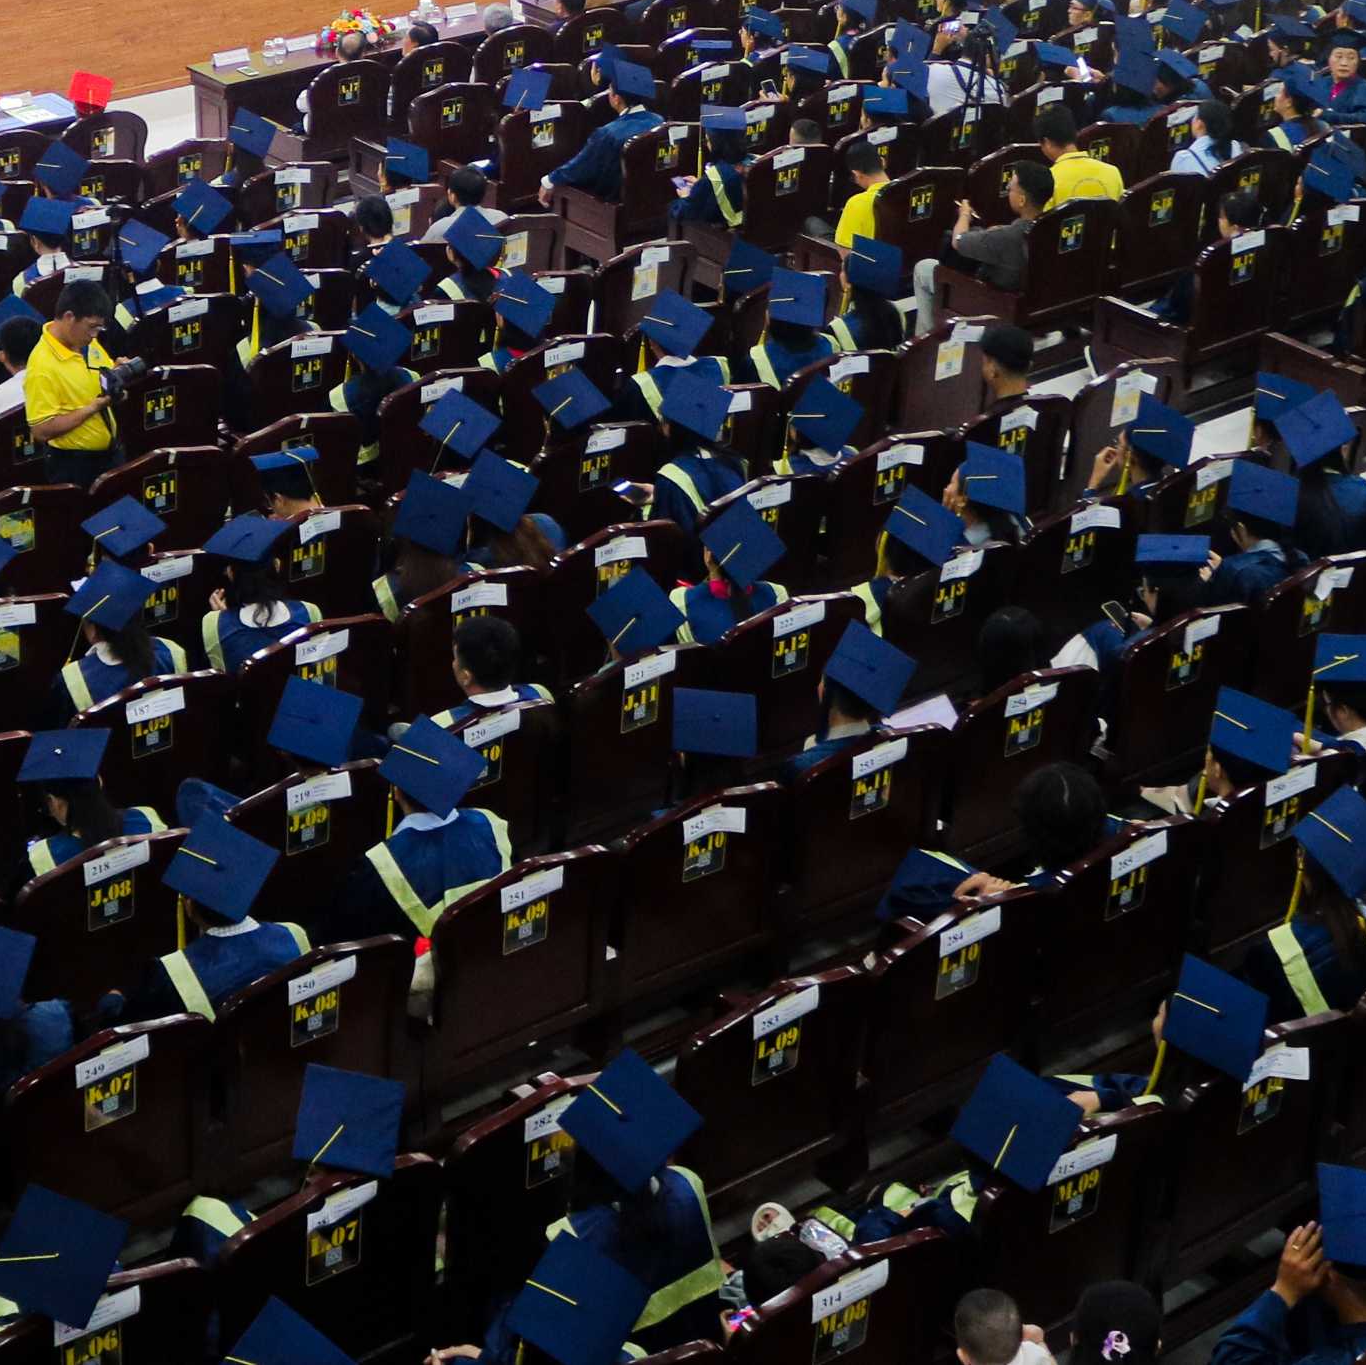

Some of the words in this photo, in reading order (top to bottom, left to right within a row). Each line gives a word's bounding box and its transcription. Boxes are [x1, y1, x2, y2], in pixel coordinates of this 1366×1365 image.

[175, 322, 200, 337] E.13
[415, 331, 439, 345] F.14
[295, 361, 322, 374] F.13
[147, 395, 173, 413] F.12
[145, 480, 174, 499] G.11
[936, 583, 965, 602] J.13
[776, 634, 807, 656] J.12
[624, 686, 658, 710] J.11
[136, 718, 170, 737] I.09
[290, 808, 328, 831] J.09
[689, 834, 724, 858] K.10
[90, 865, 110, 877] 218
[1112, 870, 1145, 896] L.11
[91, 881, 131, 906] J.08
[508, 902, 546, 929] K.09
[941, 944, 979, 974] L.10
[296, 992, 338, 1021] K.08
[759, 1028, 798, 1057] L.09
[82, 1065, 105, 1079] 249
[86, 1073, 132, 1110] K.07
[1059, 1170, 1099, 1200] M.09
[311, 1221, 357, 1256] L.07
[67, 1333, 121, 1365] L.06
